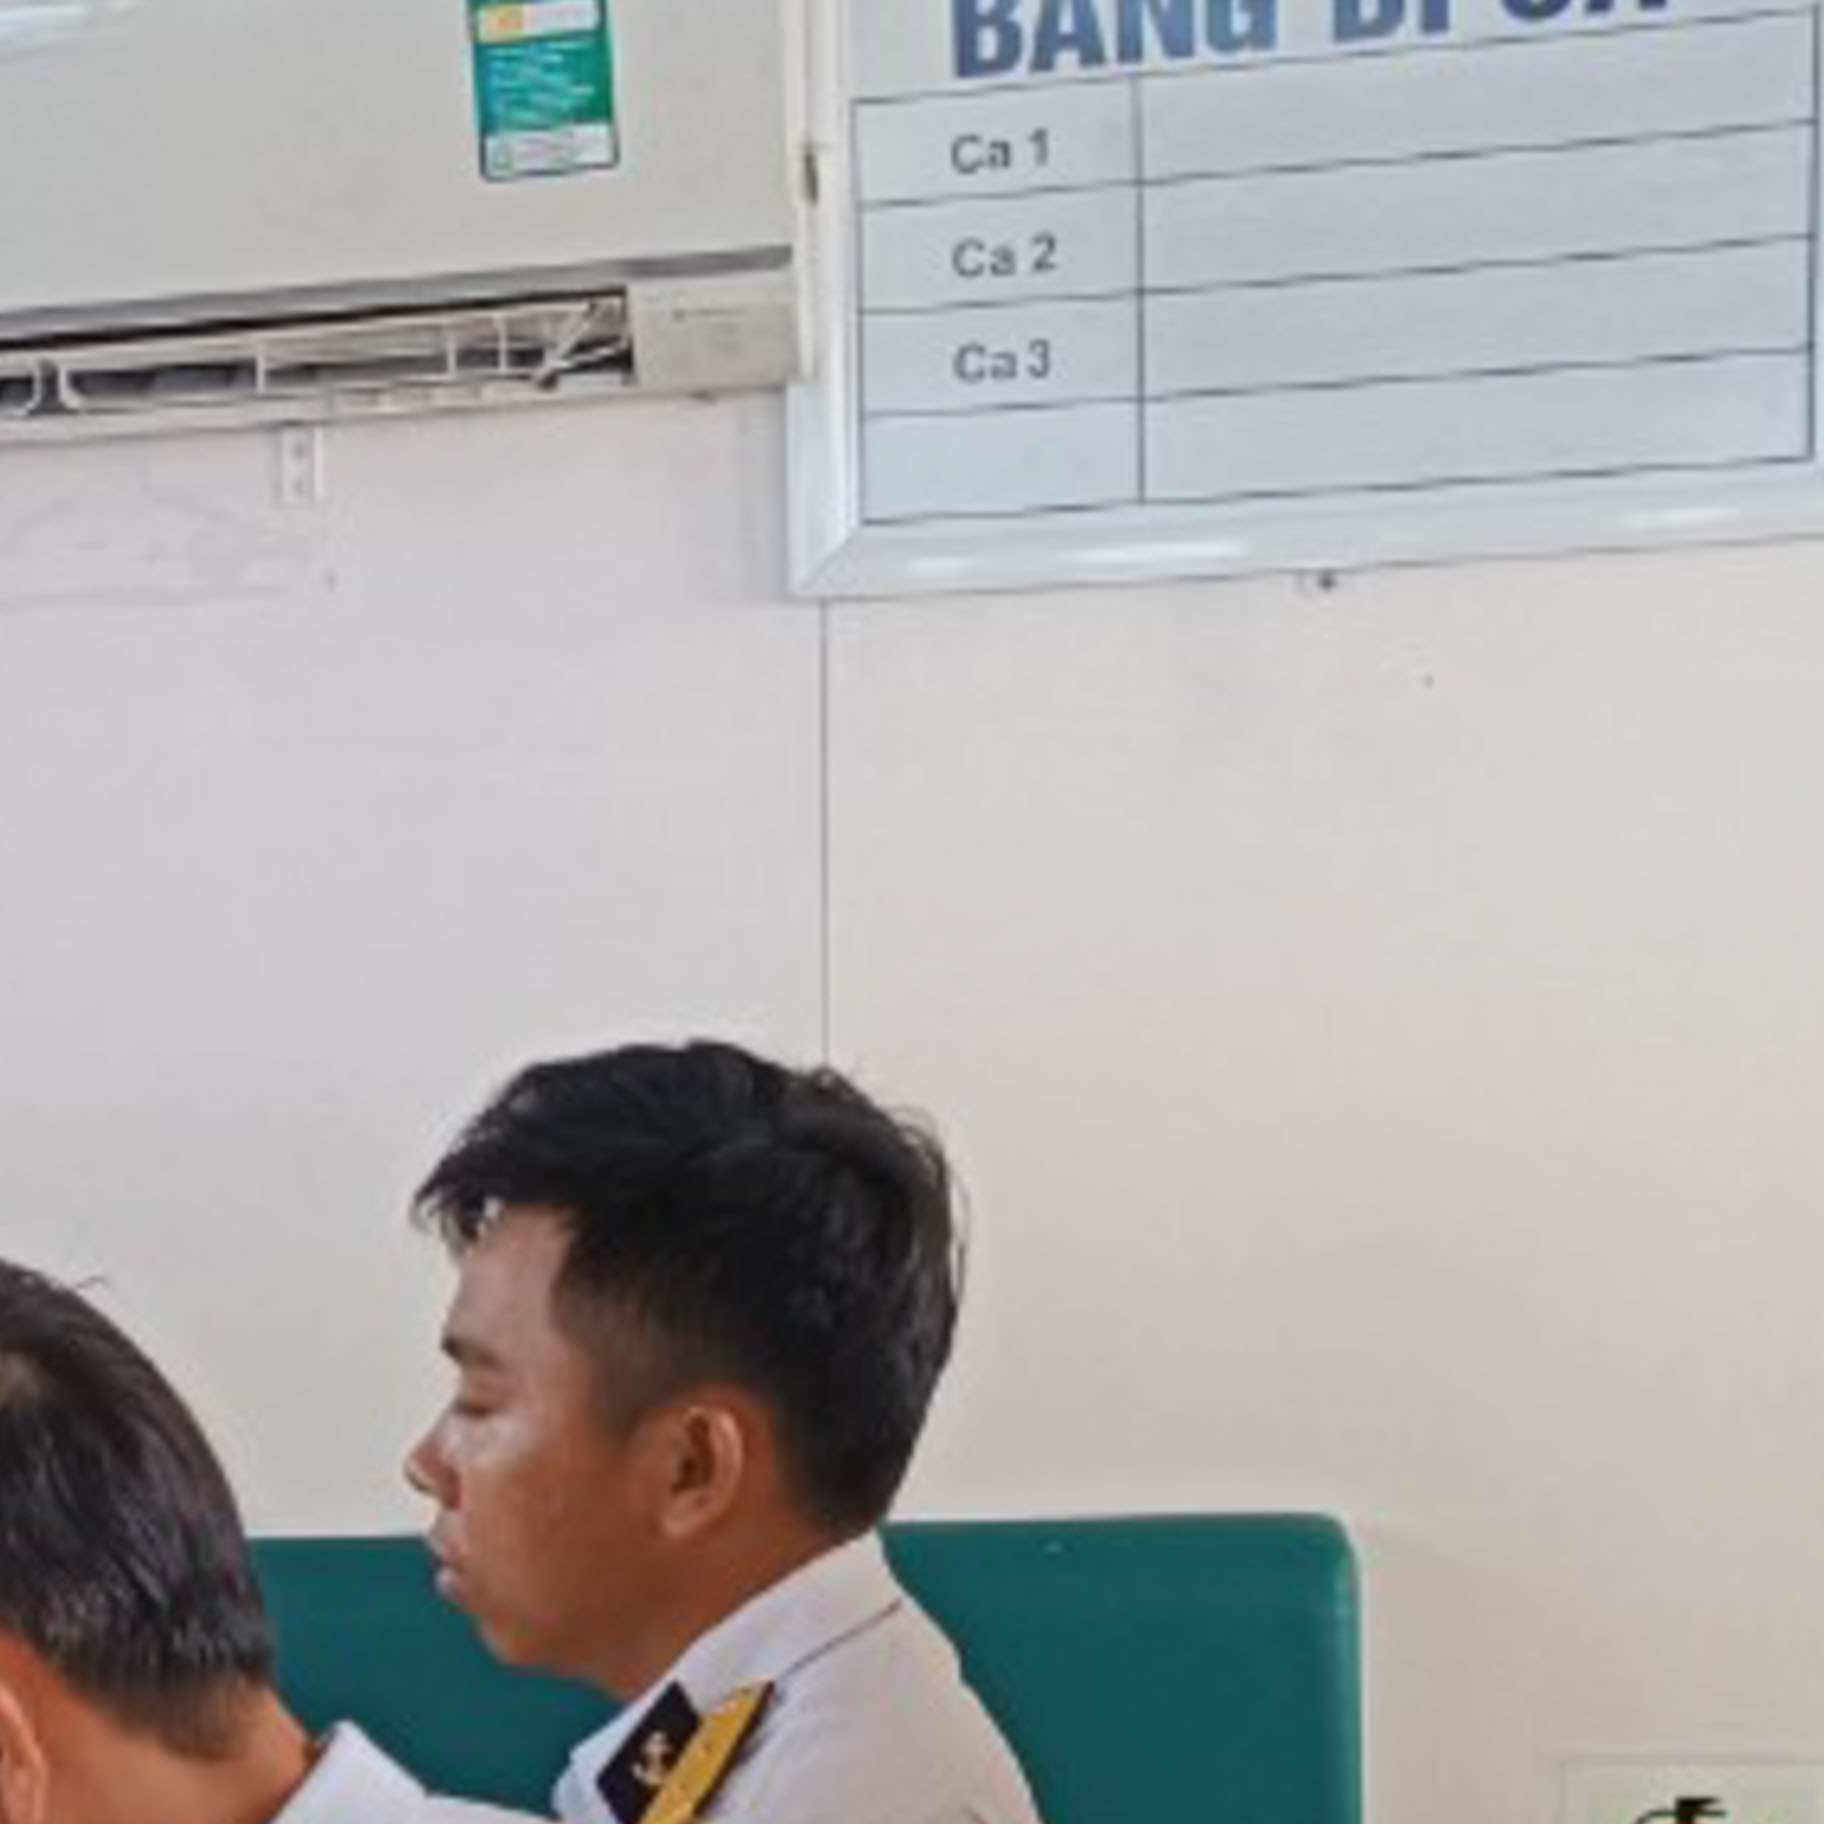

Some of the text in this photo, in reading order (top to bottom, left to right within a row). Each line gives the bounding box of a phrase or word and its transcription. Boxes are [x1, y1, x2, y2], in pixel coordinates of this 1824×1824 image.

[951, 127, 1049, 175] Ca 1
[952, 231, 1058, 279] Ca 2
[953, 337, 1052, 384] Ca 3
